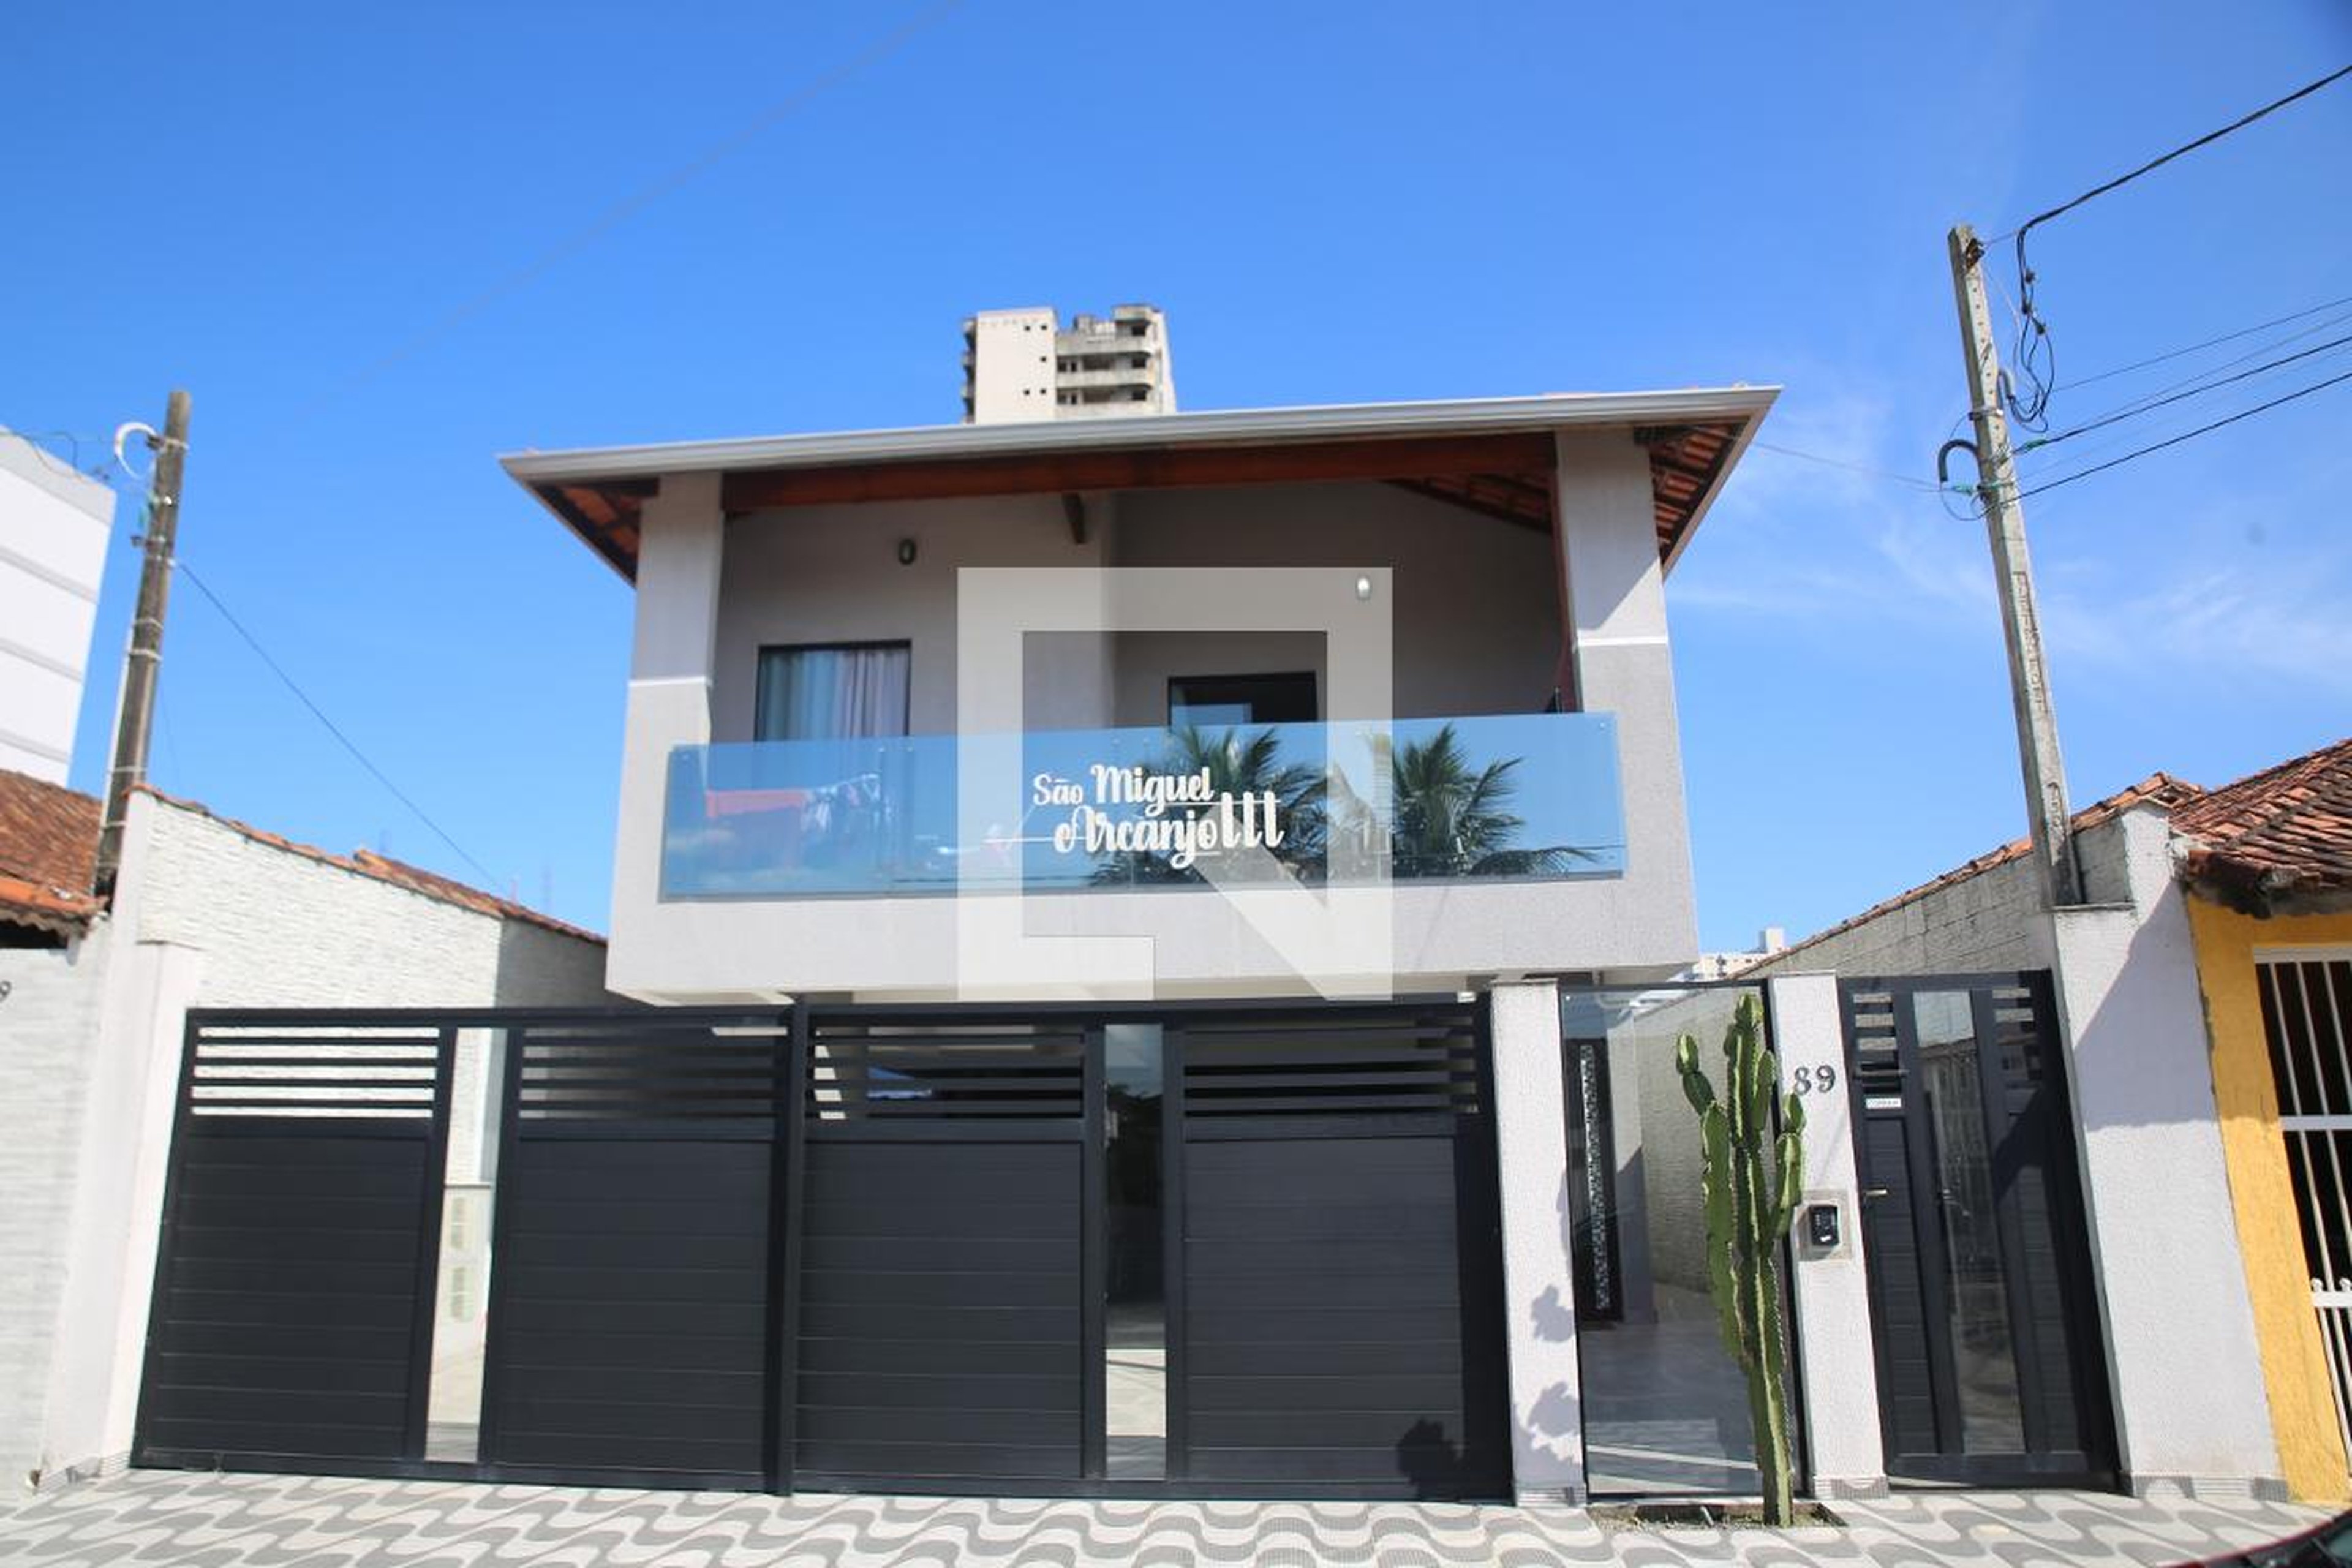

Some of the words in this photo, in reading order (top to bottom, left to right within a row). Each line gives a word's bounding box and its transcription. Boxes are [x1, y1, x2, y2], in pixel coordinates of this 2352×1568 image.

[1033, 773, 1083, 805] São
[1090, 764, 1215, 817] Miguel
[1794, 1065, 1836, 1096] 89
